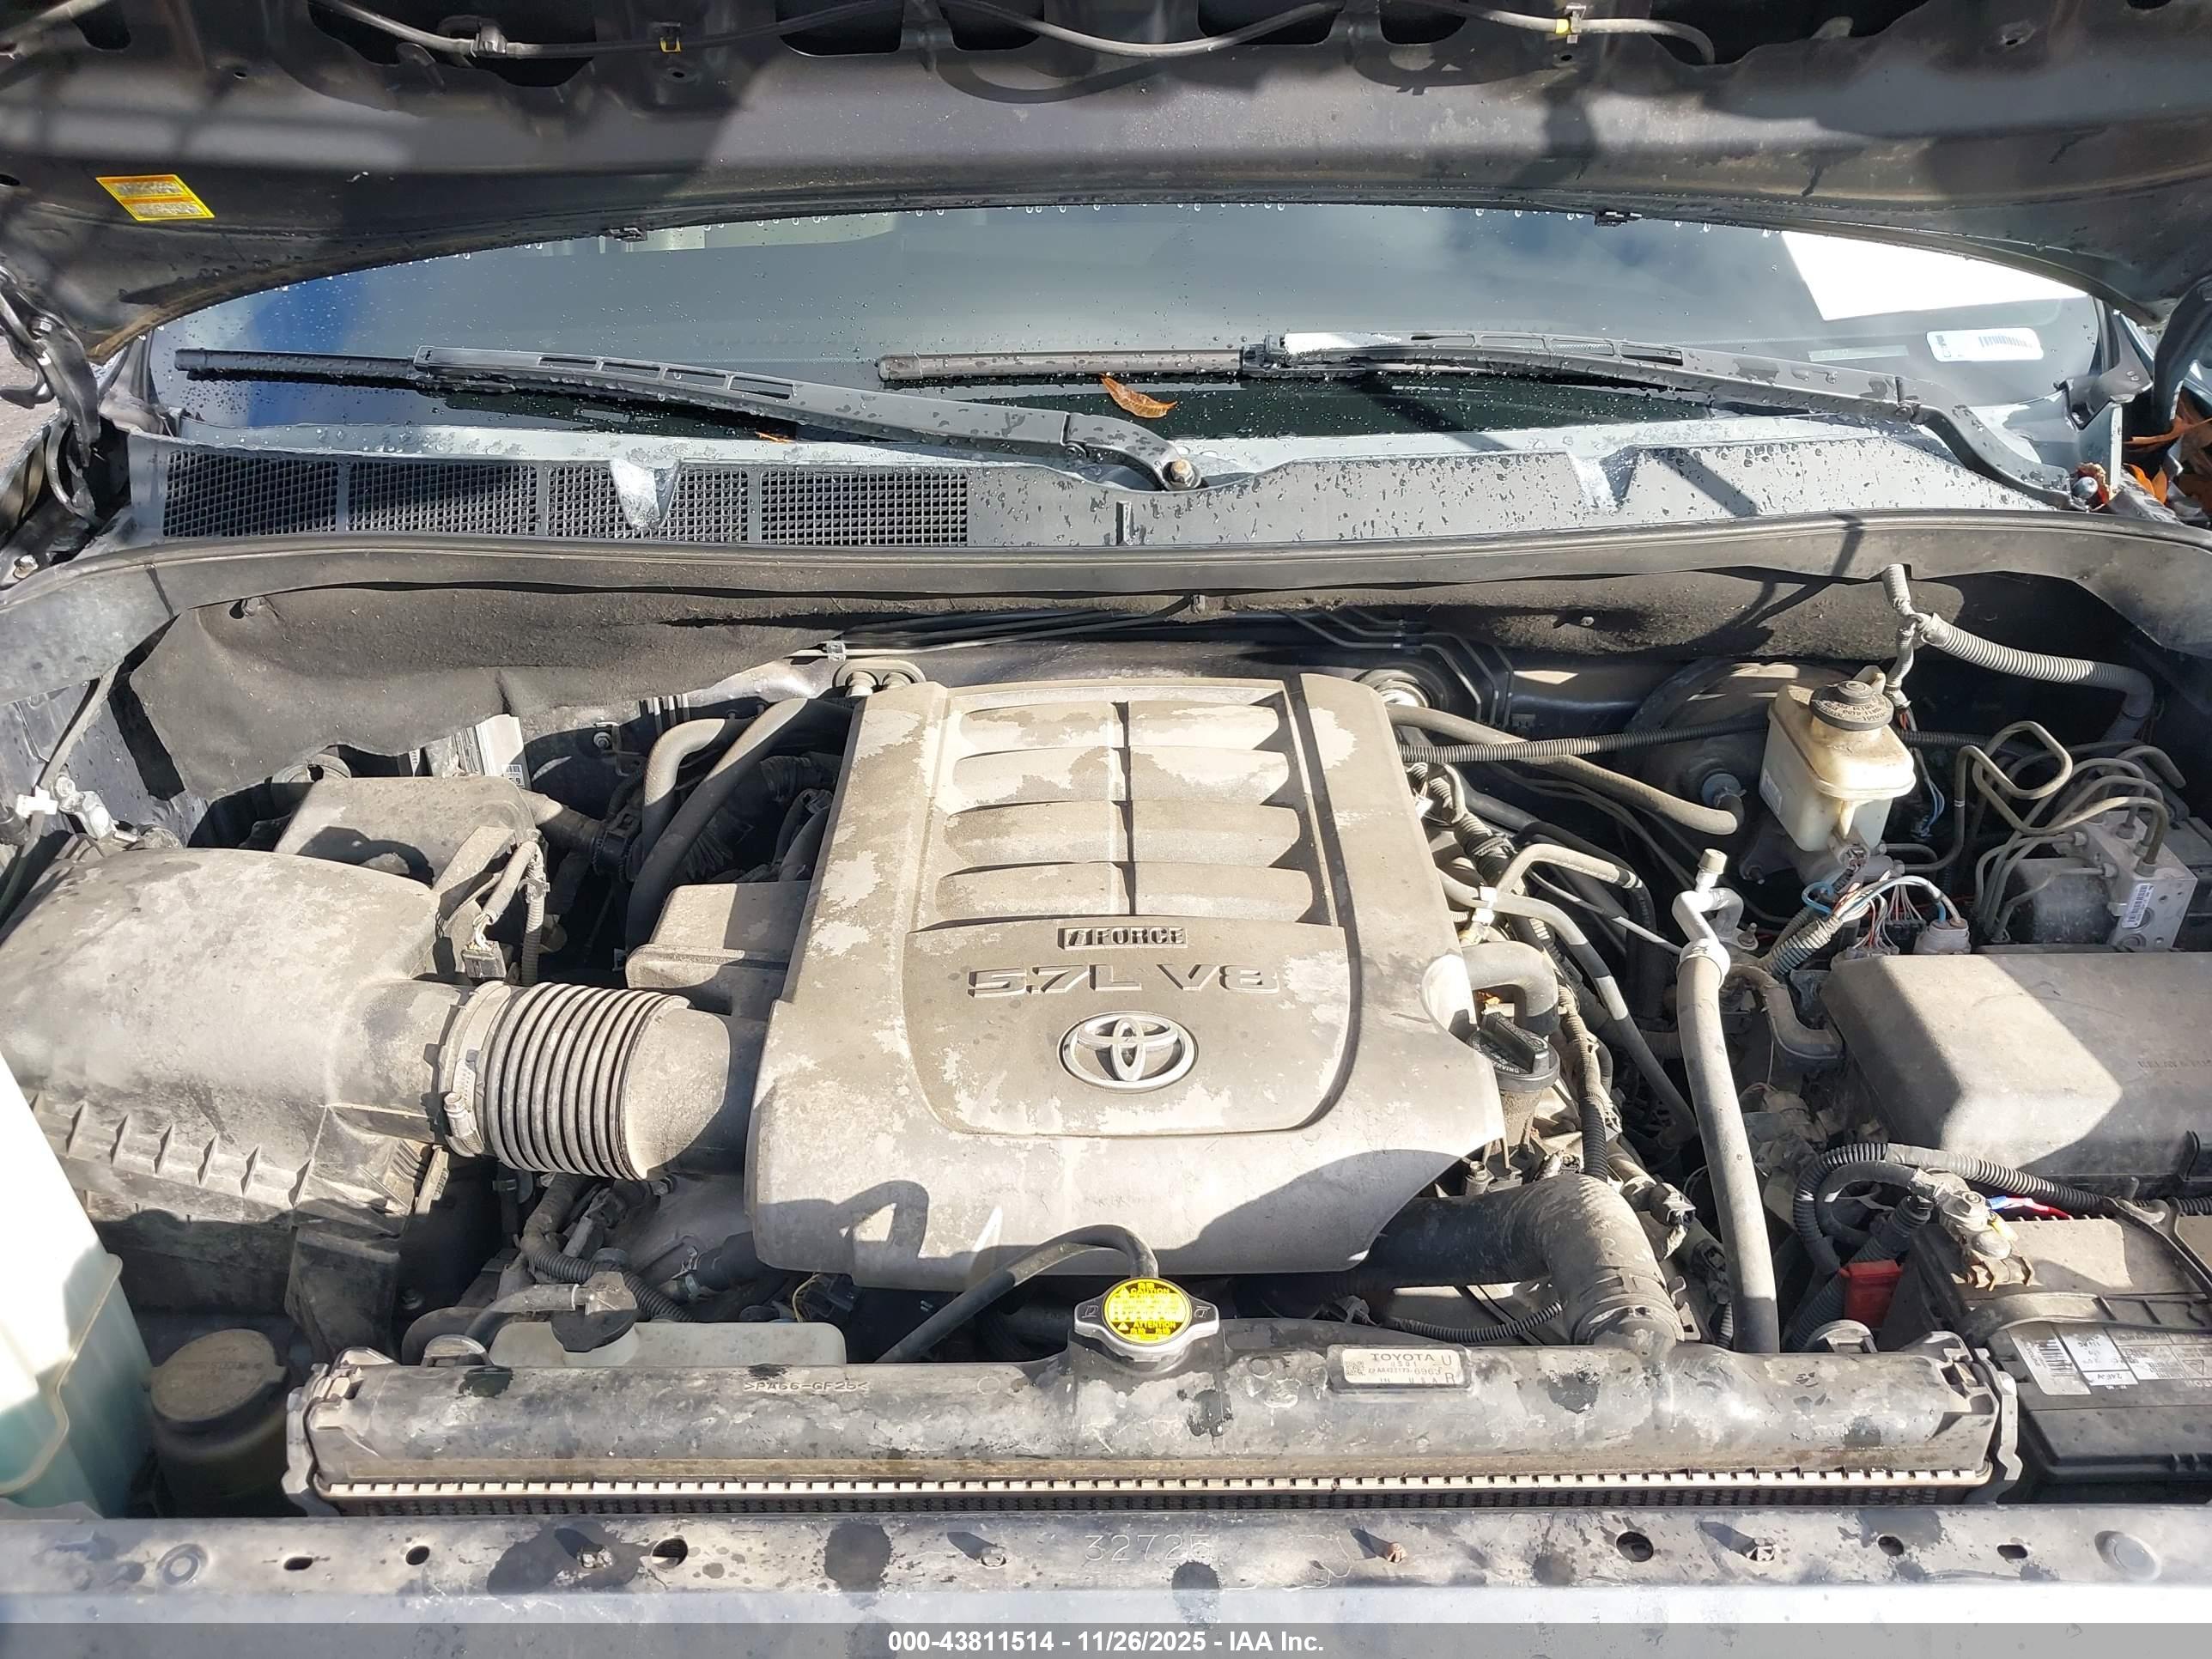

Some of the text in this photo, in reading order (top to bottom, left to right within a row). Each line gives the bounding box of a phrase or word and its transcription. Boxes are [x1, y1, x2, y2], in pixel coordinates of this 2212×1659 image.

[1156, 963, 1280, 994] V8
[1370, 1352, 1435, 1362] TOYOTA
[1085, 1534, 1211, 1561] 32725
